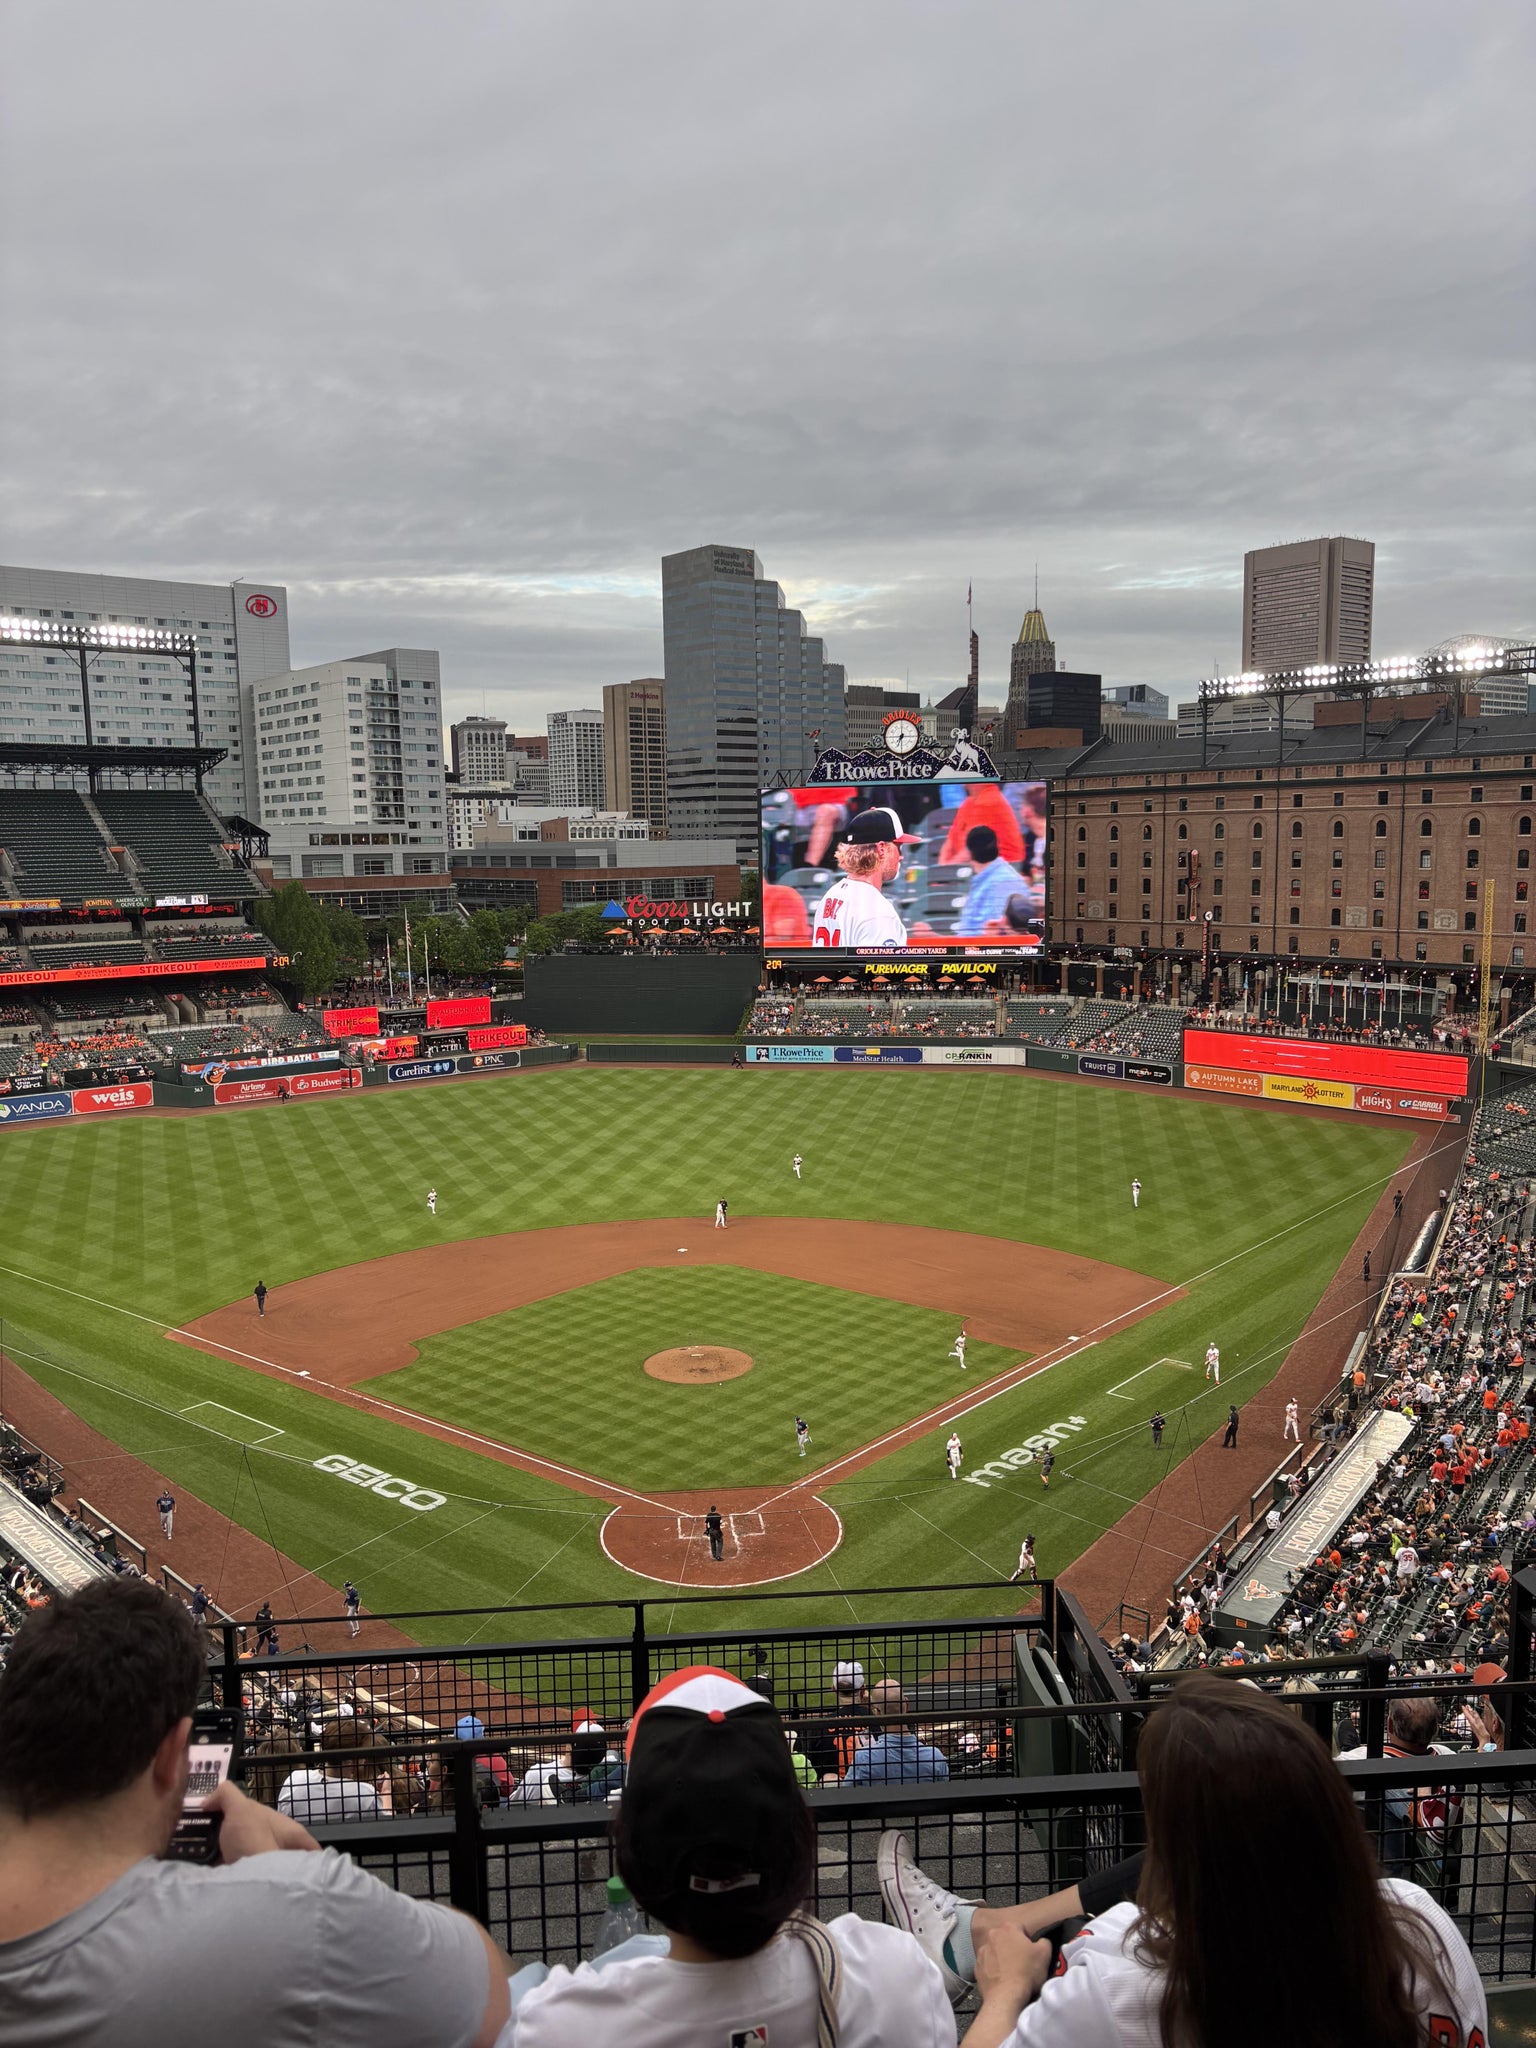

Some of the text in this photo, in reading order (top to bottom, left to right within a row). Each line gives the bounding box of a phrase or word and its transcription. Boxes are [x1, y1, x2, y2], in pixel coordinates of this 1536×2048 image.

[881, 709, 922, 726] ORIOLES
[626, 894, 753, 918] Coors LIGHT
[627, 918, 726, 926] ROOF DECK
[856, 947, 878, 955] ORIOLE
[878, 947, 895, 955] PARK
[901, 947, 925, 955] CAMDEN
[925, 947, 947, 955] YARDS
[273, 956, 289, 967] 2:09
[766, 960, 782, 970] 2:09
[139, 963, 199, 974] STRIKEOUT
[864, 963, 996, 974] PUREWAGER PAVILION
[261, 1057, 286, 1066] BIRD
[287, 1053, 312, 1063] BATH
[484, 1054, 503, 1064] PNC
[395, 1064, 433, 1078] CareFirst
[1084, 1062, 1107, 1071] TRUIST
[1201, 1073, 1258, 1086] AUTUMN LAKE
[241, 1083, 266, 1091] Airtemp
[1271, 1083, 1303, 1093] MARYLAND
[1317, 1090, 1345, 1099] LOTTERY
[91, 1088, 135, 1104] weis
[1361, 1095, 1392, 1110] HIGH'S
[11, 1100, 65, 1114] VANDA
[1412, 1099, 1443, 1109] CARROLL
[1333, 1455, 1376, 1491] ORIOLES
[313, 1454, 447, 1511] GEICO
[1318, 1488, 1350, 1511] THE
[0, 1510, 55, 1552] WELCOME
[1284, 1520, 1326, 1553] HOME
